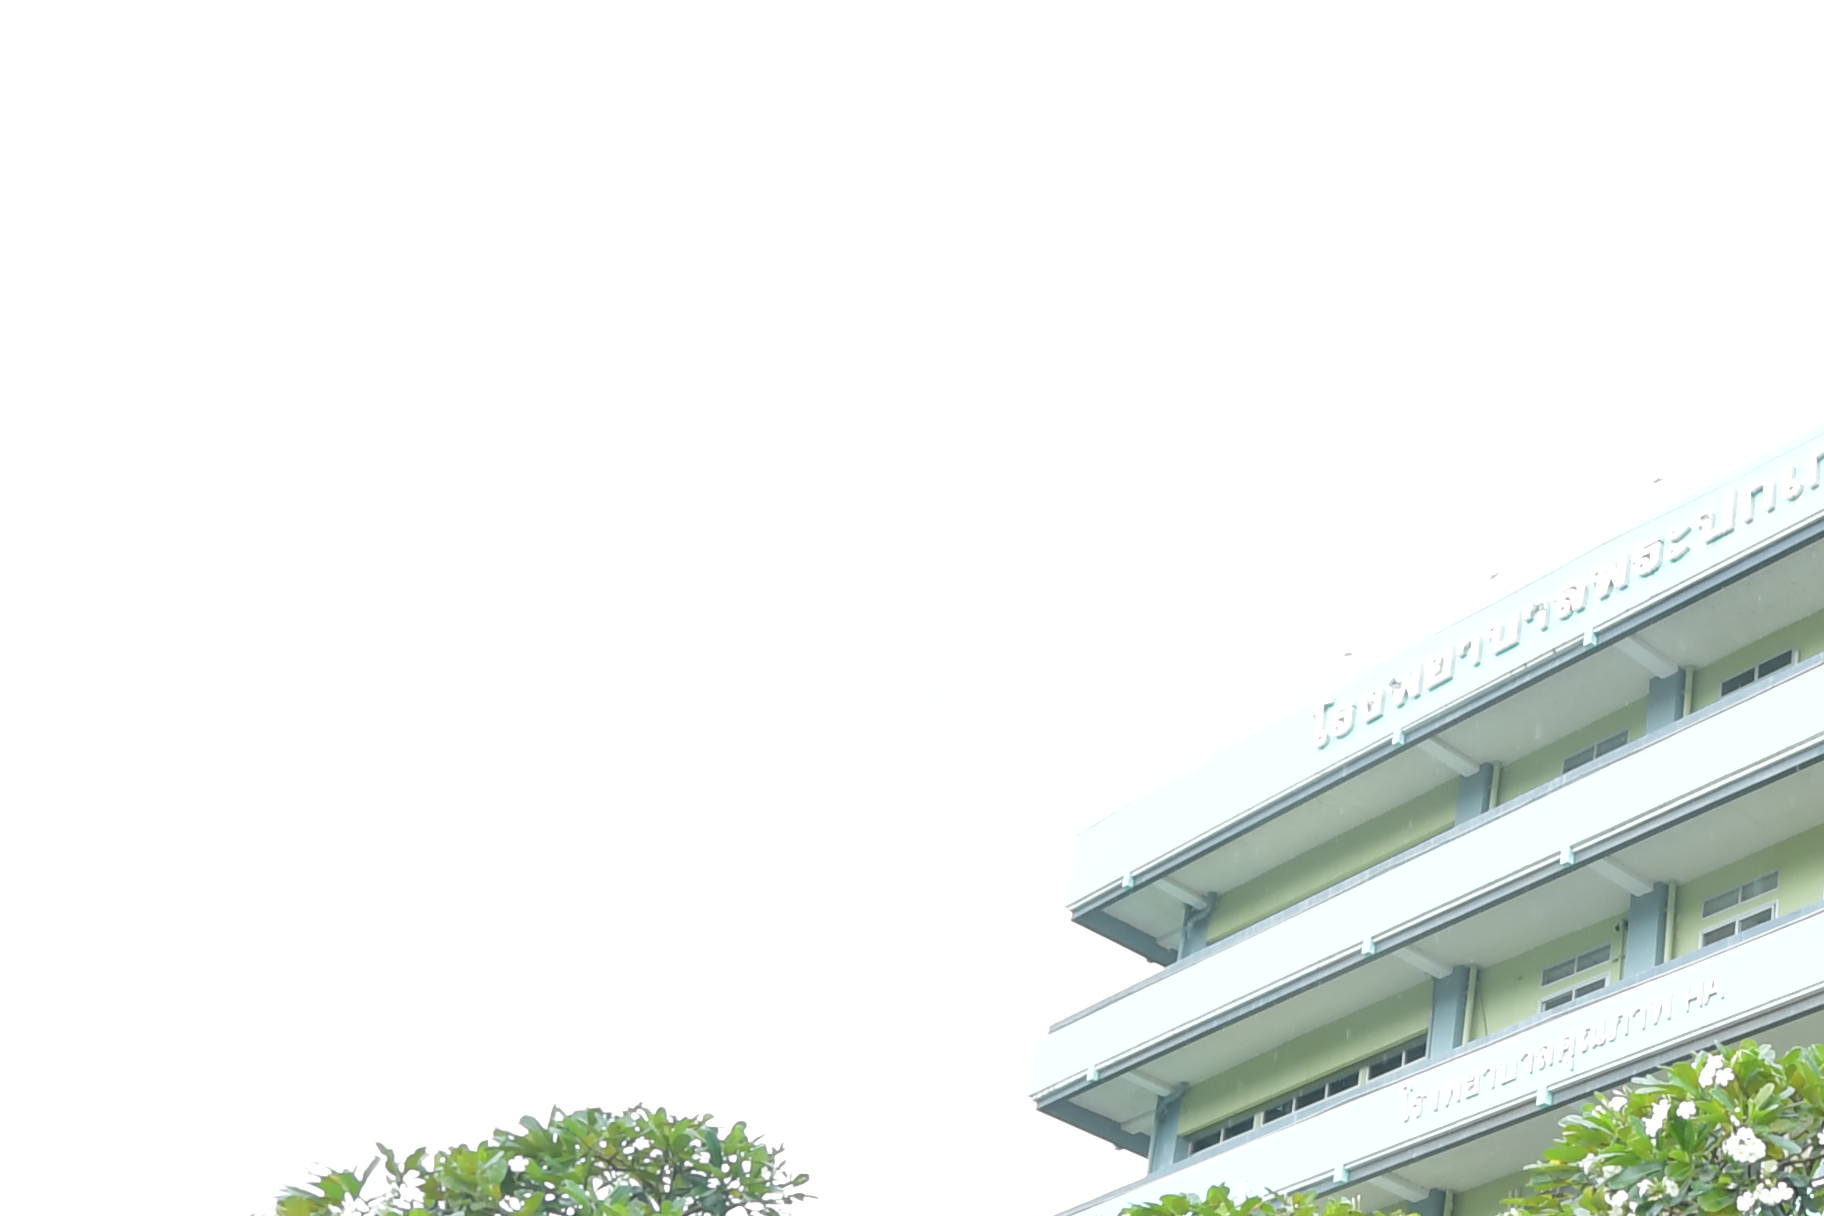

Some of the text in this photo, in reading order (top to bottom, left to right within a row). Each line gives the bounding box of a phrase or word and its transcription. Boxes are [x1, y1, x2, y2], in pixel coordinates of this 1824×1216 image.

[1399, 976, 1726, 1124] โรงพยาบาลคุณภาพ HA
